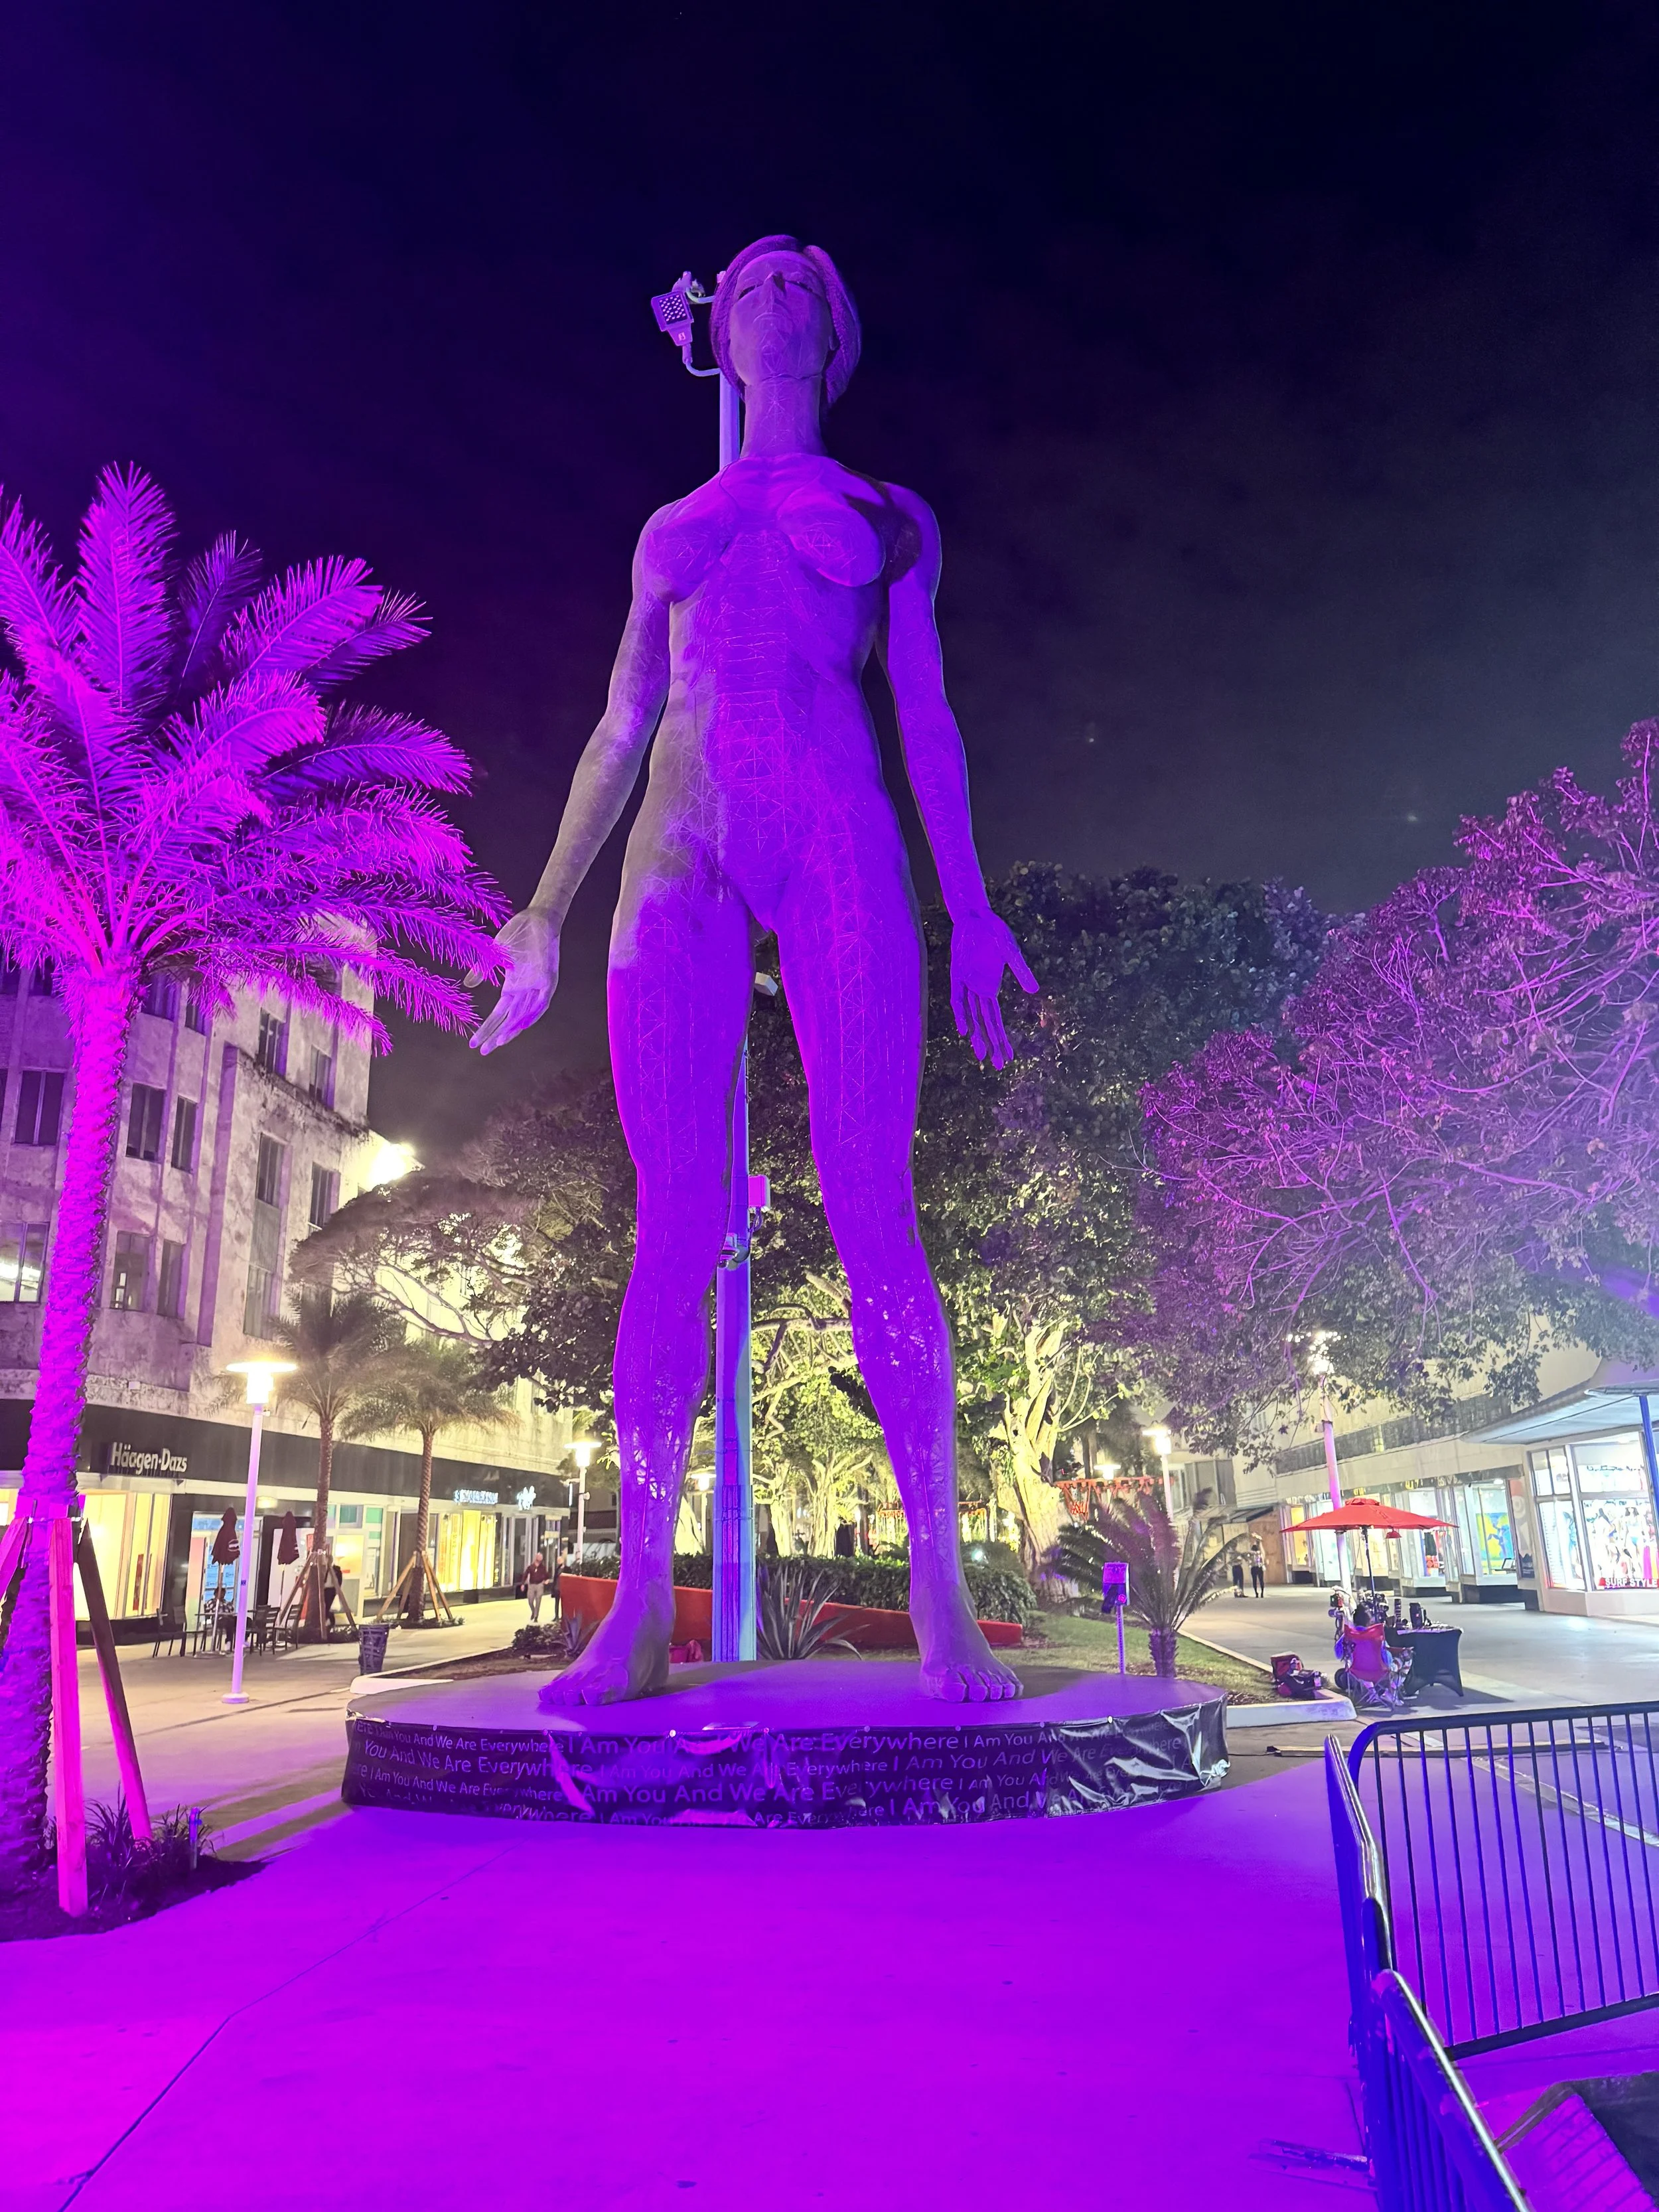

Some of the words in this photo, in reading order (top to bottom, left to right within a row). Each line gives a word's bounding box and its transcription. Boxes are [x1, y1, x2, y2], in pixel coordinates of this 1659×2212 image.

[1605, 1578, 1628, 1587] SURF
[1629, 1578, 1658, 1587] STYLE
[394, 1730, 411, 1743] You
[413, 1733, 433, 1747] And
[435, 1734, 453, 1749] We
[455, 1737, 477, 1751] Are
[569, 1736, 573, 1753] I
[580, 1737, 618, 1754] Am
[624, 1737, 665, 1754] You
[773, 1733, 814, 1752] Are
[822, 1732, 959, 1754] Everywhere
[964, 1735, 968, 1748] I
[974, 1735, 1001, 1748] Am
[1004, 1732, 1033, 1746] You
[365, 1740, 388, 1759] You
[390, 1745, 416, 1765] And
[417, 1749, 440, 1770] We
[444, 1754, 472, 1773] Are
[609, 1764, 636, 1779] Am
[641, 1765, 672, 1779] You
[678, 1763, 713, 1779] And
[718, 1763, 747, 1777] We
[787, 1759, 888, 1779] Everywhere
[894, 1755, 899, 1771] I
[905, 1755, 943, 1771] Am
[950, 1754, 988, 1769] You
[993, 1748, 1037, 1767] And
[1072, 1745, 1096, 1763] Are
[370, 1766, 374, 1779] I
[375, 1767, 390, 1783] Am
[393, 1771, 410, 1787] You
[412, 1775, 433, 1791] And
[436, 1779, 457, 1793] We
[459, 1782, 480, 1796] Are
[583, 1784, 618, 1803] Am
[624, 1785, 666, 1803] You
[674, 1781, 723, 1803] And
[729, 1782, 766, 1802] We
[773, 1782, 815, 1804] Are
[822, 1775, 954, 1800] Everywhere
[960, 1778, 963, 1790] I
[997, 1773, 1025, 1787] You
[482, 1801, 593, 1820] verywhere
[610, 1812, 637, 1824] Am
[890, 1798, 895, 1816] I
[991, 1791, 1029, 1810] And
